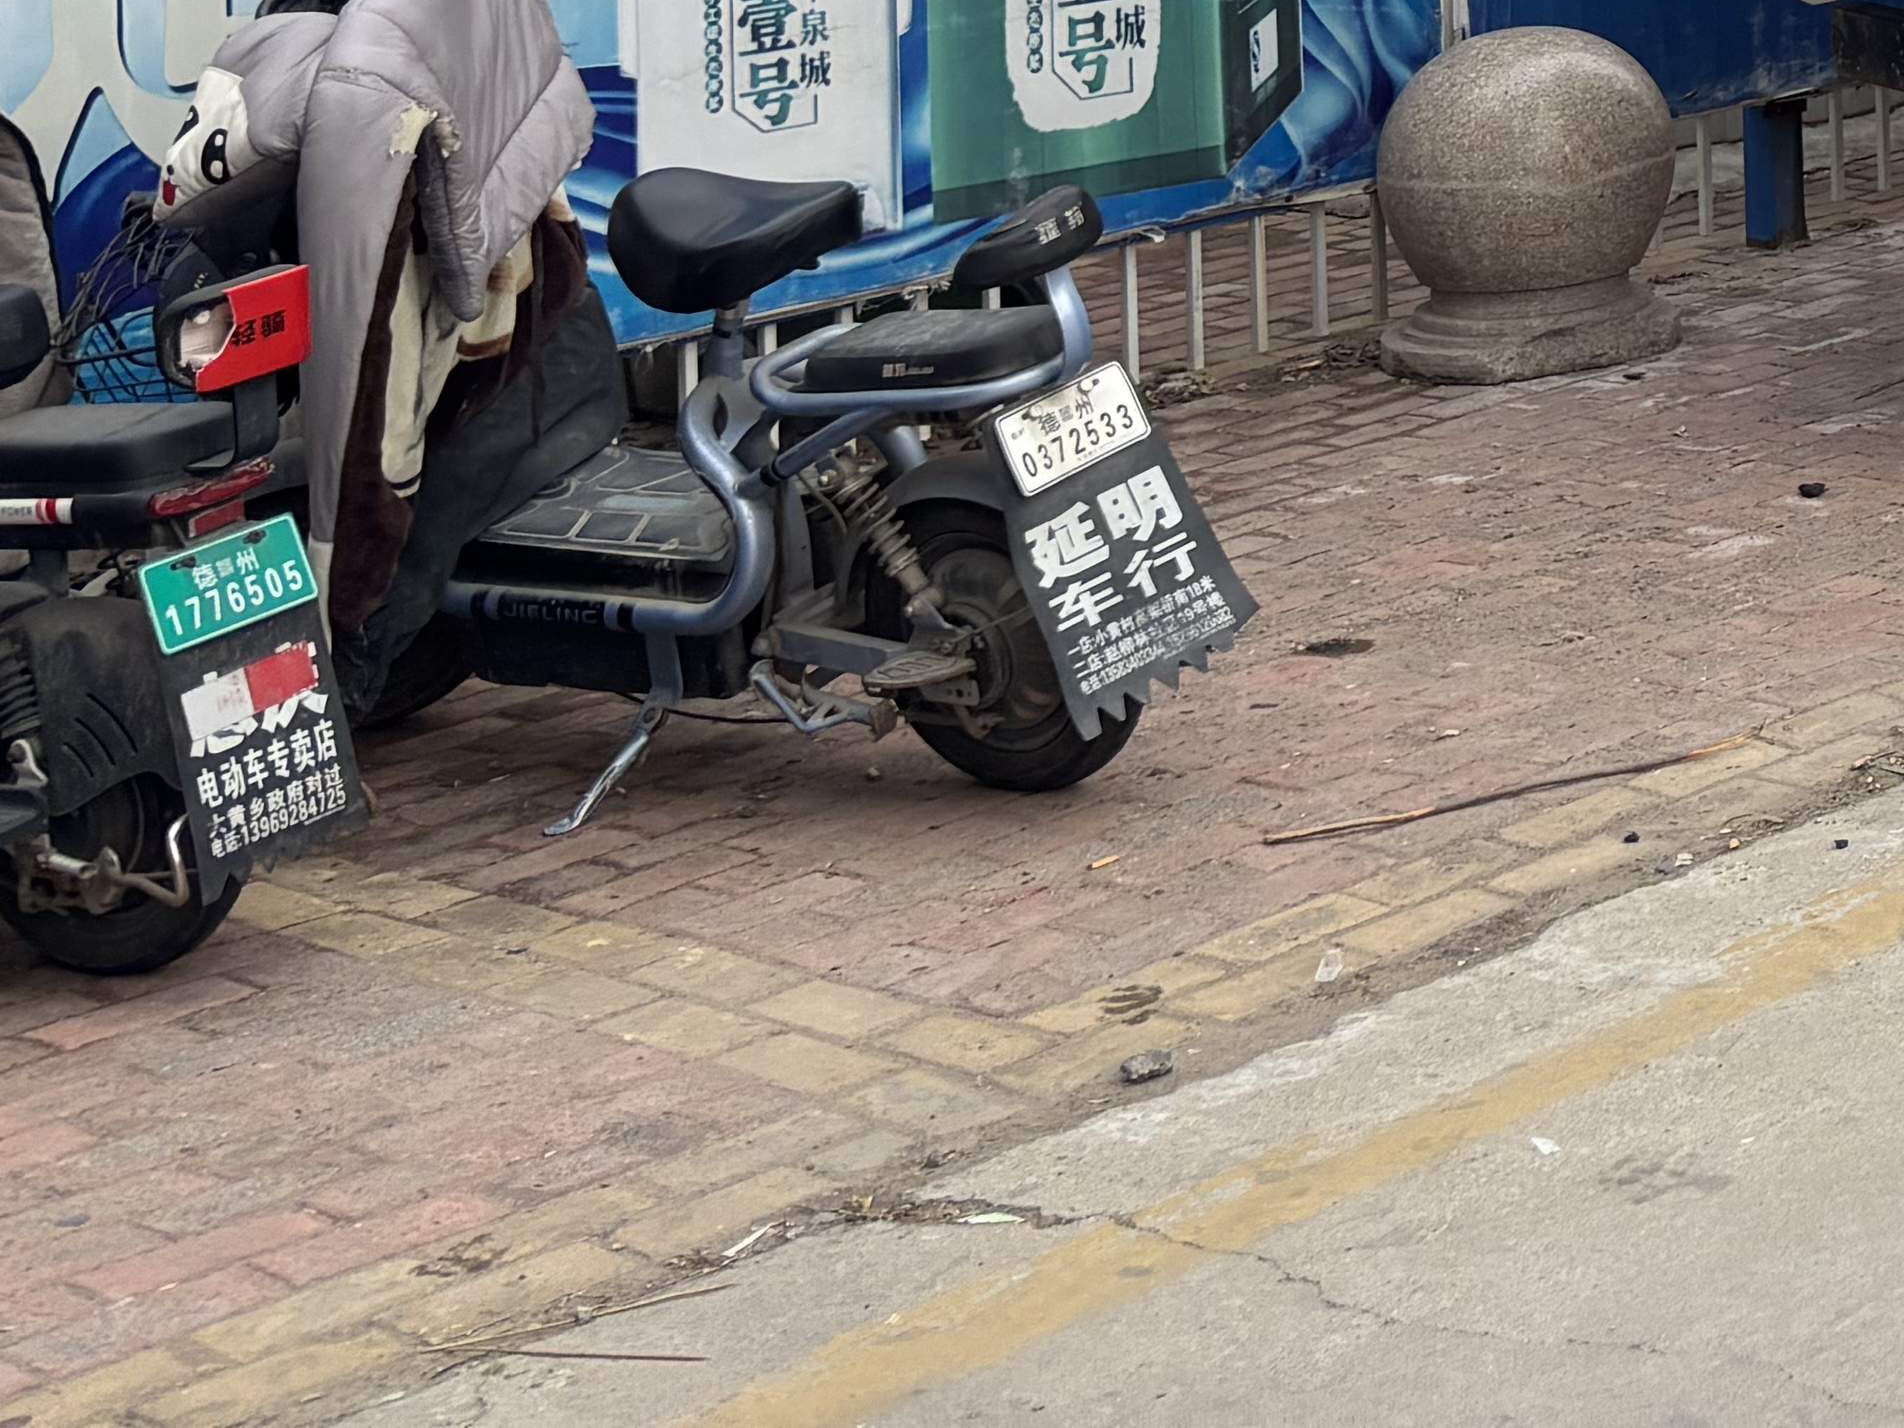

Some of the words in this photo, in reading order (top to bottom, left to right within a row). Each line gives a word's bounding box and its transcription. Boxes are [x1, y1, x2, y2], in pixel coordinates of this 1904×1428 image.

[800, 9, 832, 88] 泉城
[1022, 403, 1134, 478] 0372533
[1024, 464, 1184, 589] 延明
[165, 558, 304, 637] 1776505
[1048, 531, 1198, 633] 车行
[196, 717, 338, 809] 电动车专卖店
